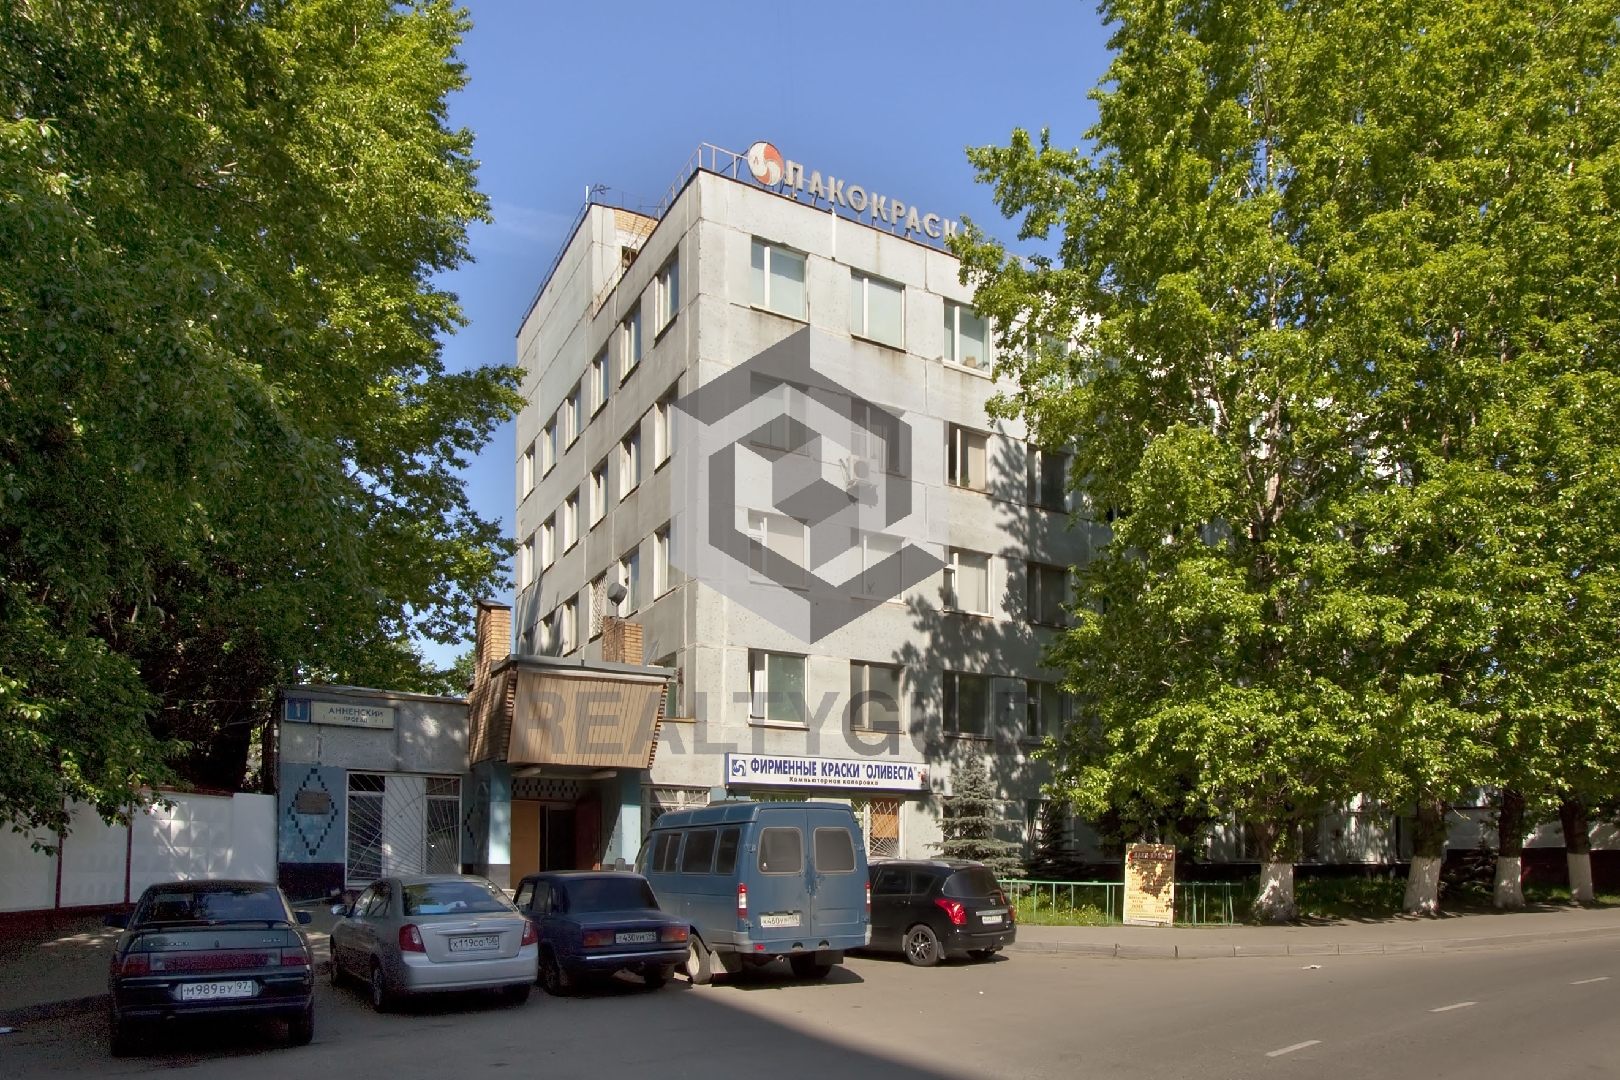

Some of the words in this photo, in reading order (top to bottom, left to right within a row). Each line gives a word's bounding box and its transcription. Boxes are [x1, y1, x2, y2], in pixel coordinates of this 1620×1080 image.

[751, 758, 817, 777] ФИРМЕННЫЕ
[821, 762, 860, 778] КРАСКИ
[862, 765, 918, 781] "ОЛИВЕСТА"
[789, 776, 841, 785] Компьютерная
[186, 983, 233, 996] М989ВУ
[236, 981, 248, 990] 97
